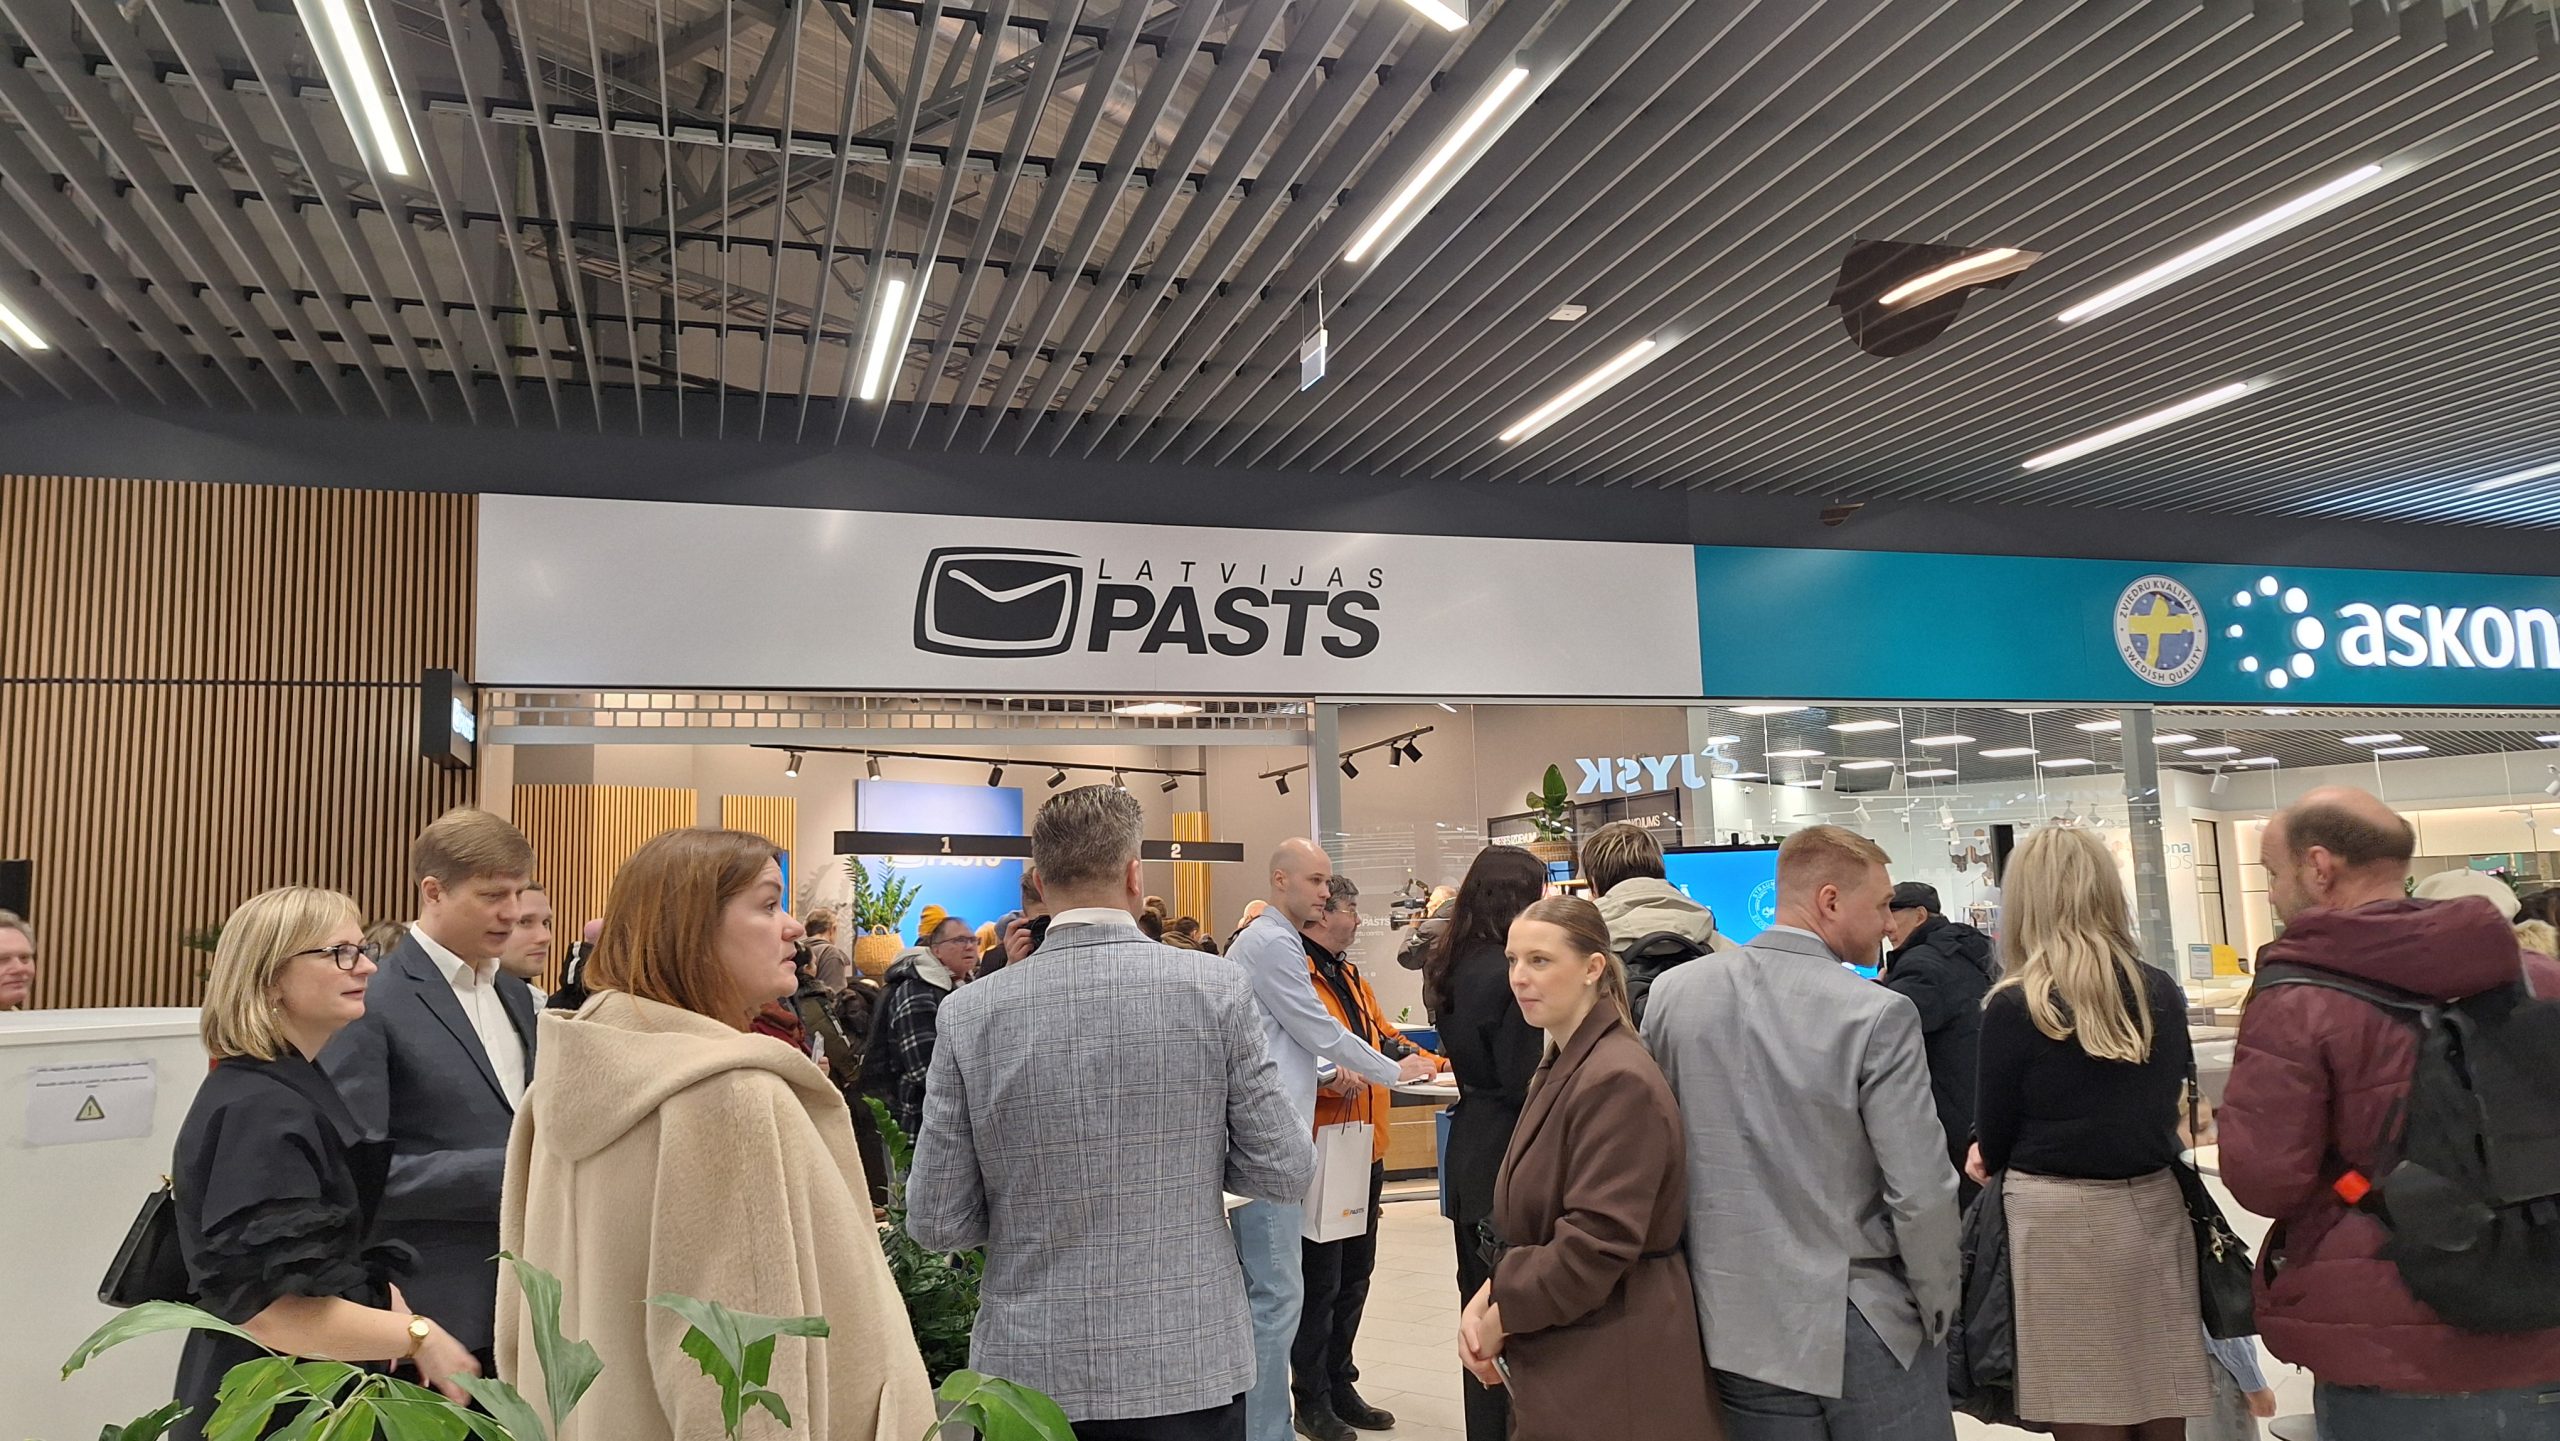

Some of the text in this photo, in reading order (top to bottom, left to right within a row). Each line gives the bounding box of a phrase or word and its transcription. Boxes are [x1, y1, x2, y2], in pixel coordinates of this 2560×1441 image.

[1098, 558, 1383, 588] LATVIJAS
[2119, 581, 2151, 619] ZVIEDRU
[1087, 584, 1381, 659] PASTS
[2336, 602, 2560, 670] askon
[2124, 645, 2203, 683] SWEDISH QUALITY
[940, 836, 952, 853] 1
[1170, 843, 1182, 859] 2
[2164, 842, 2191, 854] ona
[2169, 855, 2193, 870] DS
